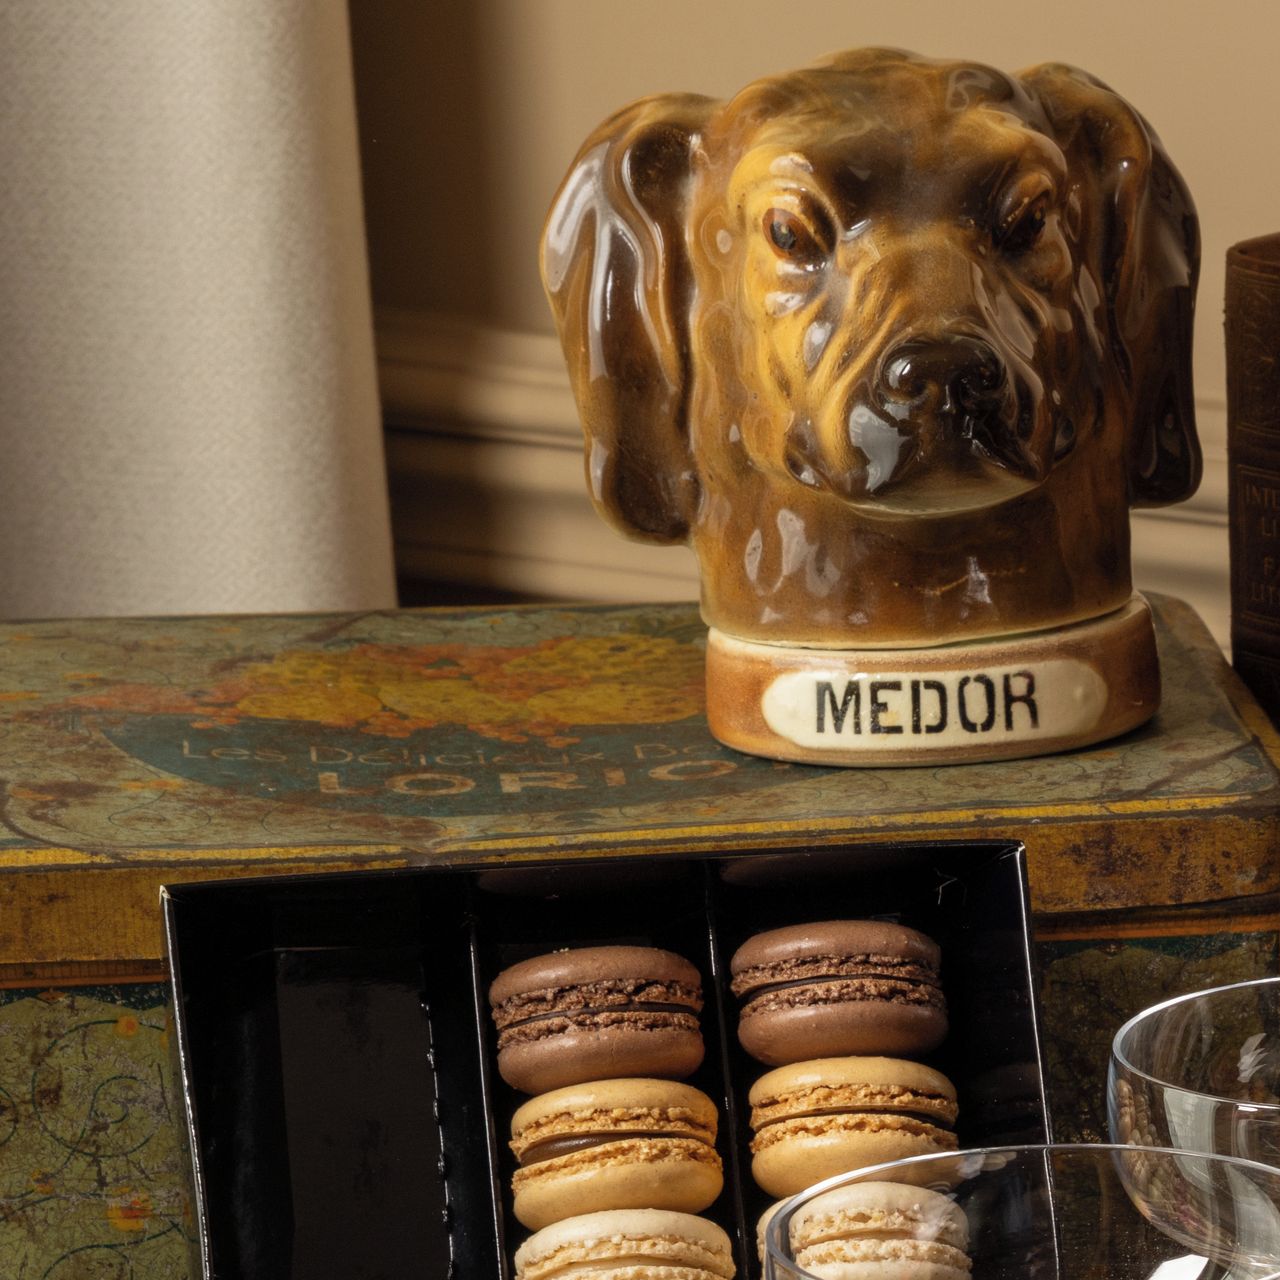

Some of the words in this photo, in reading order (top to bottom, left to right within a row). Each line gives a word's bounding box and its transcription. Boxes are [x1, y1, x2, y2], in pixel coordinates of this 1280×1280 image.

[814, 668, 1040, 736] MEDOR
[181, 738, 289, 763] Les
[318, 758, 790, 796] LORIO
